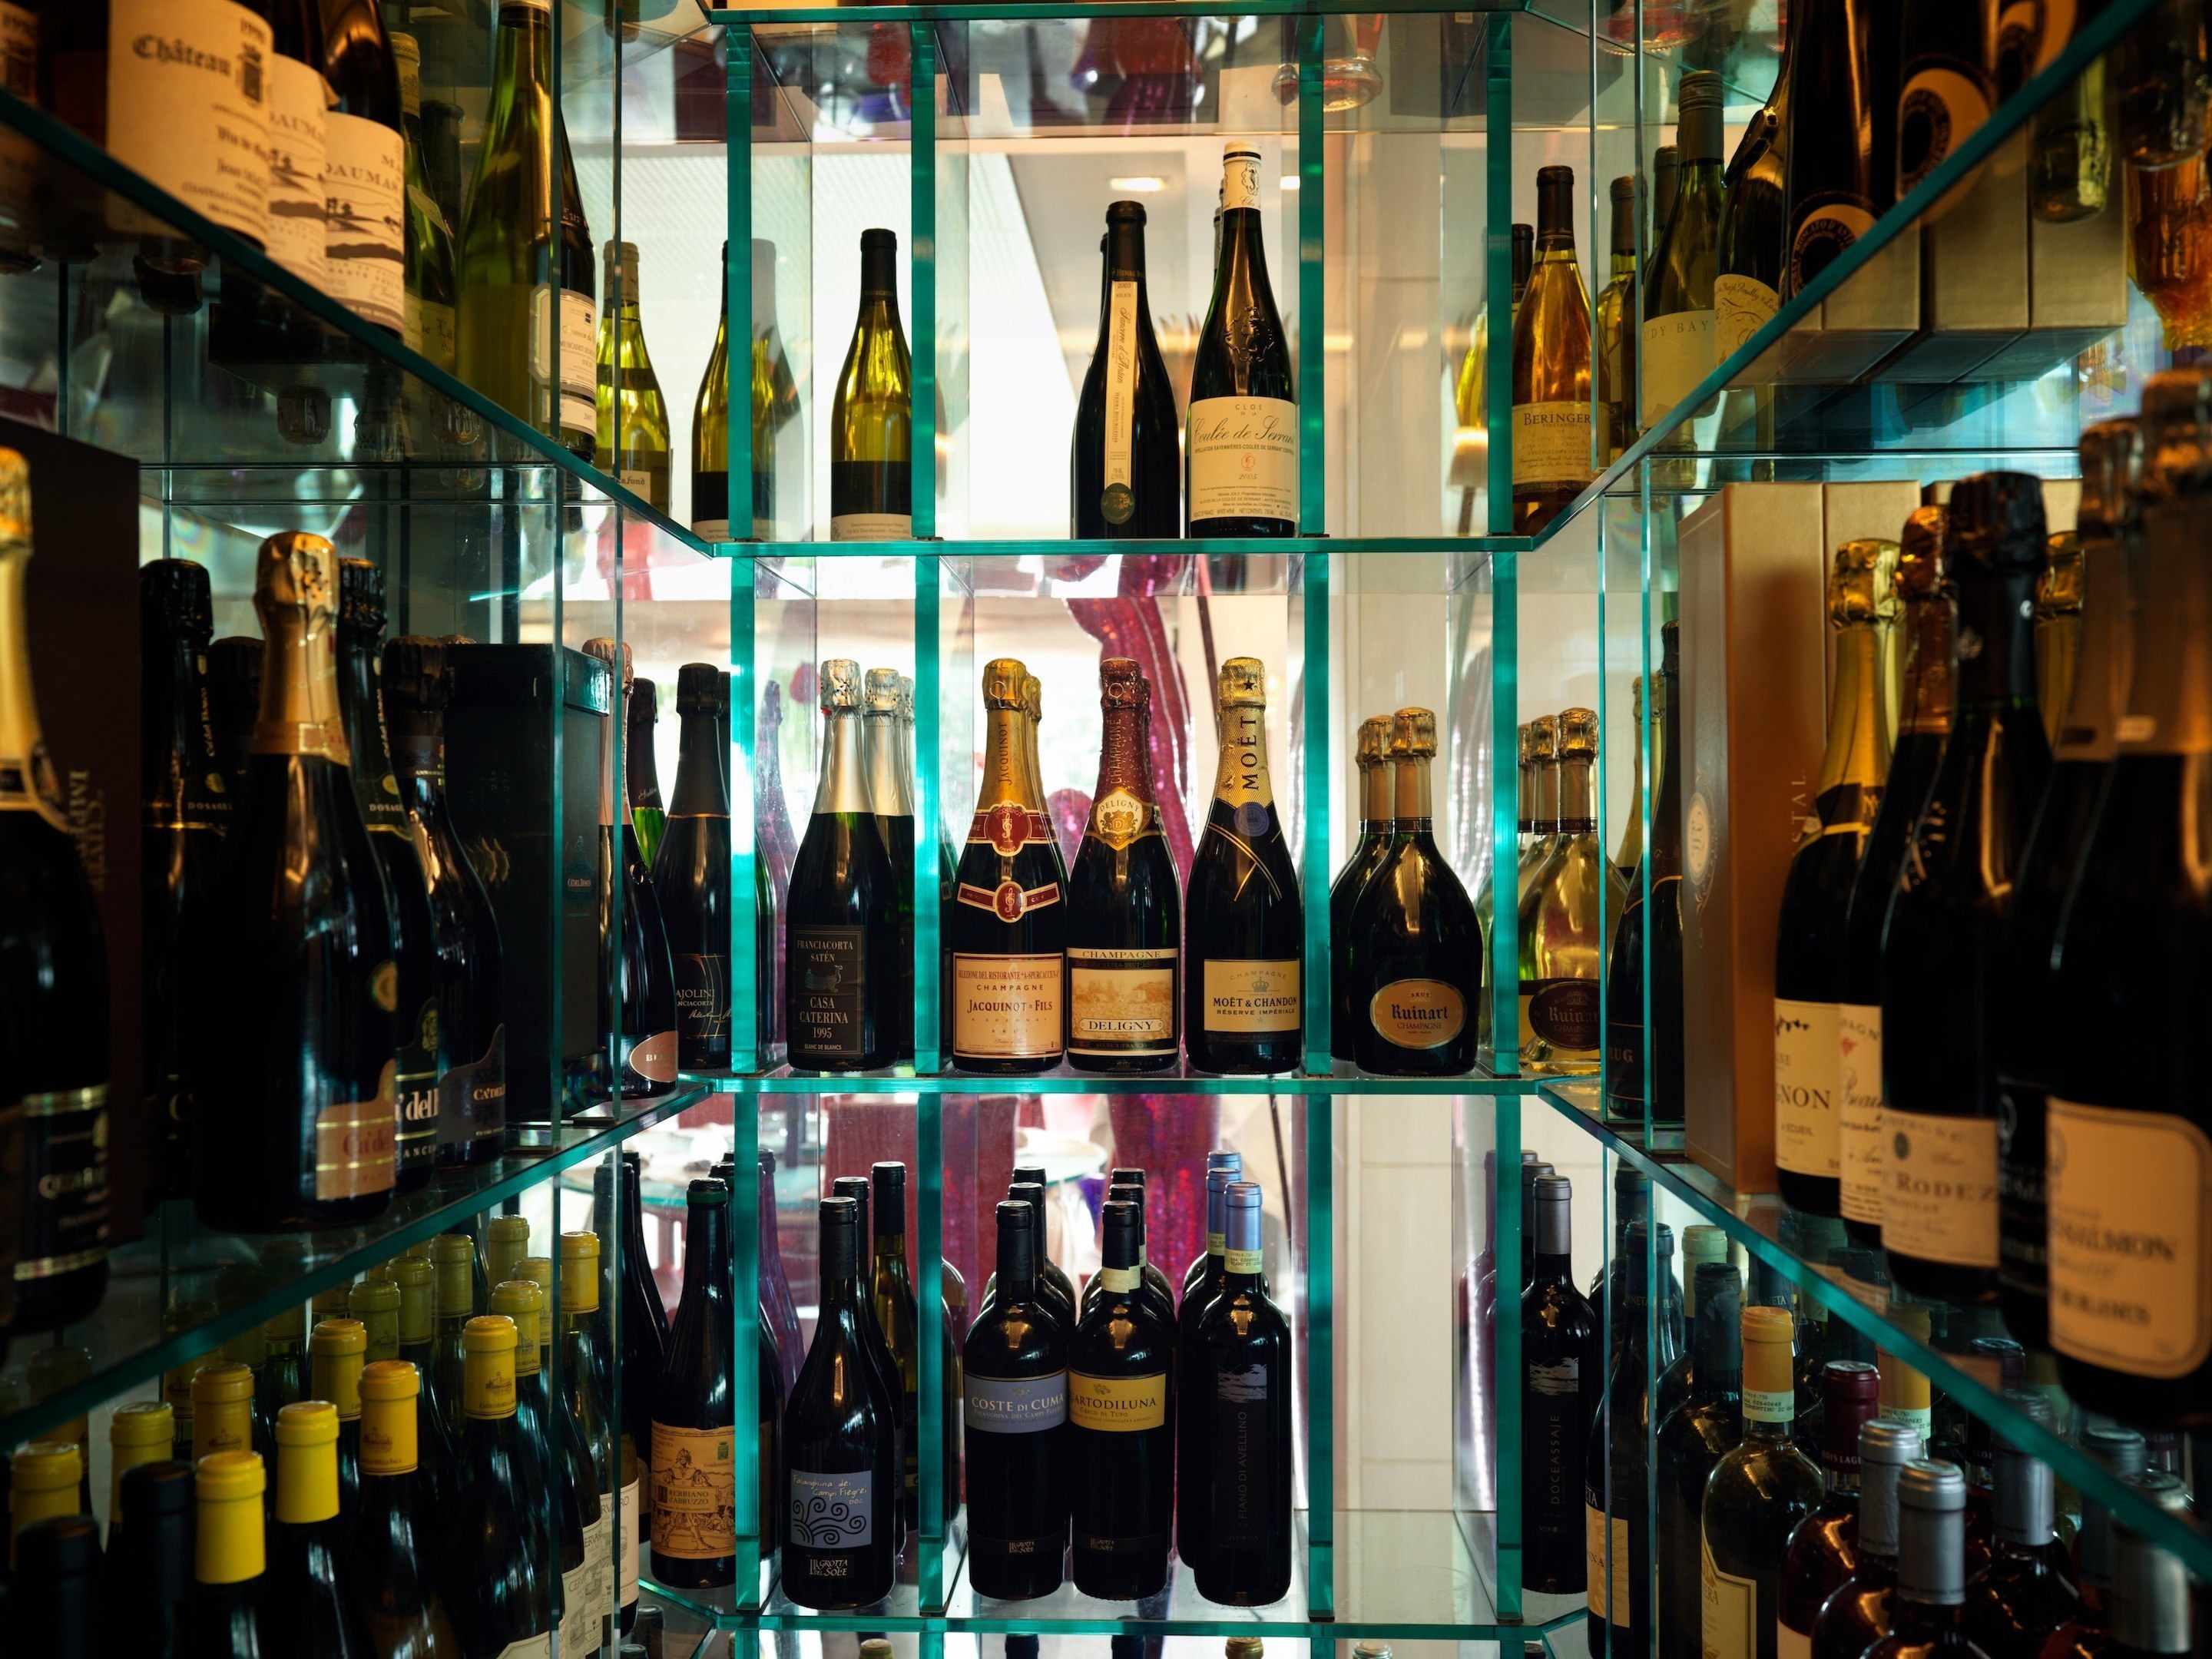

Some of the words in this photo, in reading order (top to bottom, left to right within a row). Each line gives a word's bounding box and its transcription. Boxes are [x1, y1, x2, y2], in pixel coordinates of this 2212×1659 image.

[1677, 320, 1709, 334] BAY
[1524, 412, 1591, 426] BERINGER
[1194, 417, 1228, 444] Coulée
[1233, 424, 1252, 439] de
[998, 723, 1012, 785] JACQUINOT
[1238, 716, 1259, 790] MOËT
[1099, 800, 1140, 812] DELIGNY
[797, 940, 853, 950] FRANCIACORTA
[810, 951, 836, 962] SATÉN
[979, 971, 988, 979] DEL
[989, 971, 1020, 980] RISTORANTE
[1230, 971, 1286, 980] CHAMPAGNE
[810, 997, 836, 1009] CASA
[967, 999, 1027, 1013] JACQUINOT
[1035, 1000, 1052, 1011] FILS
[1213, 996, 1243, 1007] MOËT
[1254, 996, 1297, 1007] CHANDON
[800, 1012, 849, 1024] CATERINA
[1391, 1004, 1449, 1020] Ruinart
[1548, 1006, 1599, 1023] Ruinar
[813, 1027, 833, 1038] 1995
[1089, 1021, 1154, 1031] DELIGNY
[972, 1397, 1013, 1412] COSTE
[1031, 1393, 1064, 1411] CUMA
[1080, 1407, 1098, 1416] GRECO
[1237, 1412, 1247, 1468] AVELLINO
[793, 1475, 833, 1489] Falanghina
[838, 1479, 851, 1487] dei
[1238, 1469, 1247, 1482] DI
[813, 1488, 837, 1501] Campi
[839, 1485, 867, 1498] Flegrei
[1238, 1485, 1247, 1519] FIANO
[819, 1559, 848, 1568] GROTTA
[824, 1568, 848, 1577] SOLE
